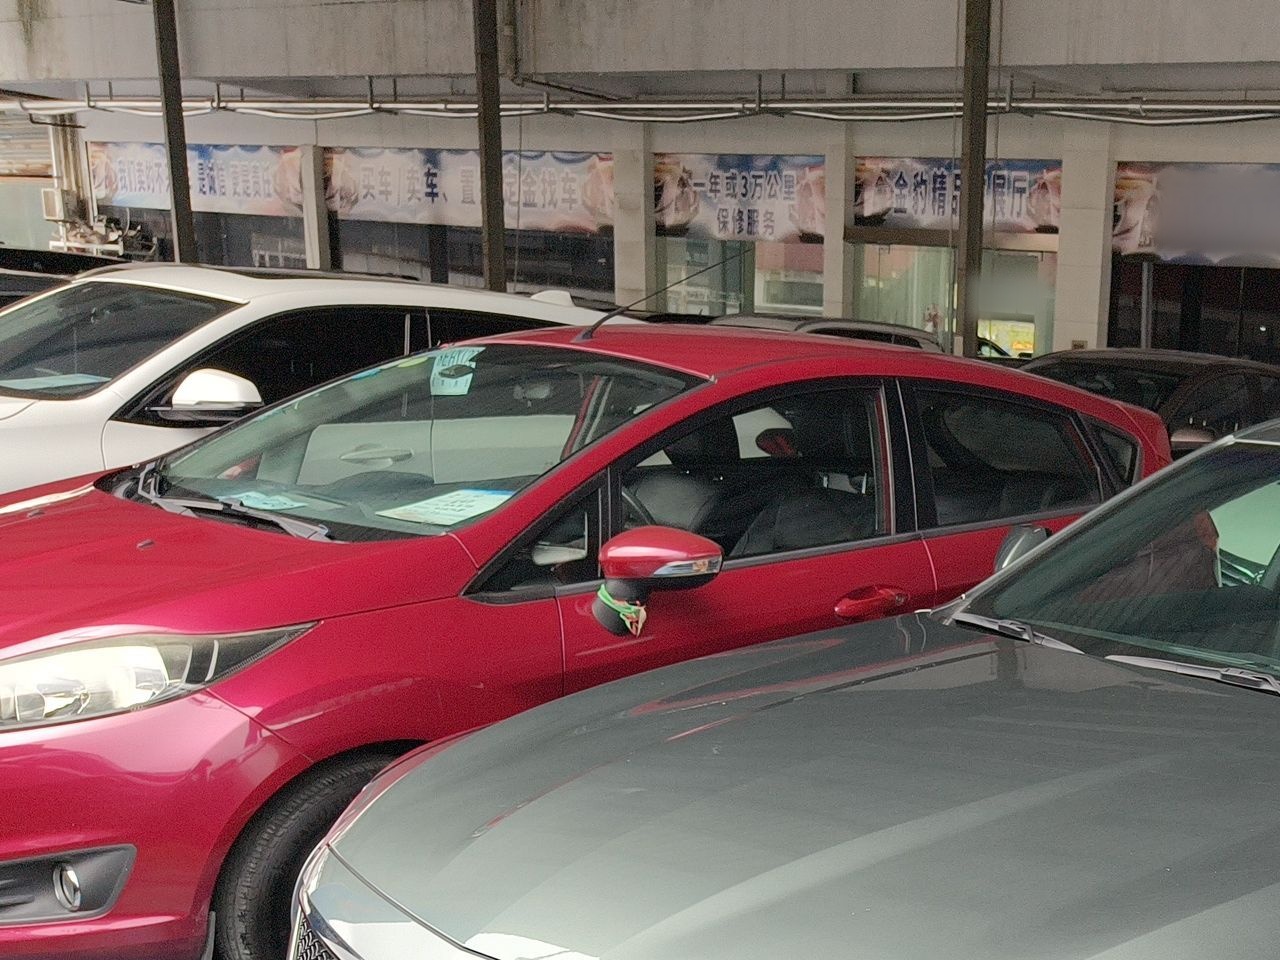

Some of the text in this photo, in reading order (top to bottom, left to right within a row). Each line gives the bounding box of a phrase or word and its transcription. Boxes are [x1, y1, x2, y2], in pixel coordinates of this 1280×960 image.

[692, 171, 796, 201] 一年或3万公里
[716, 207, 776, 236] 保修服务
